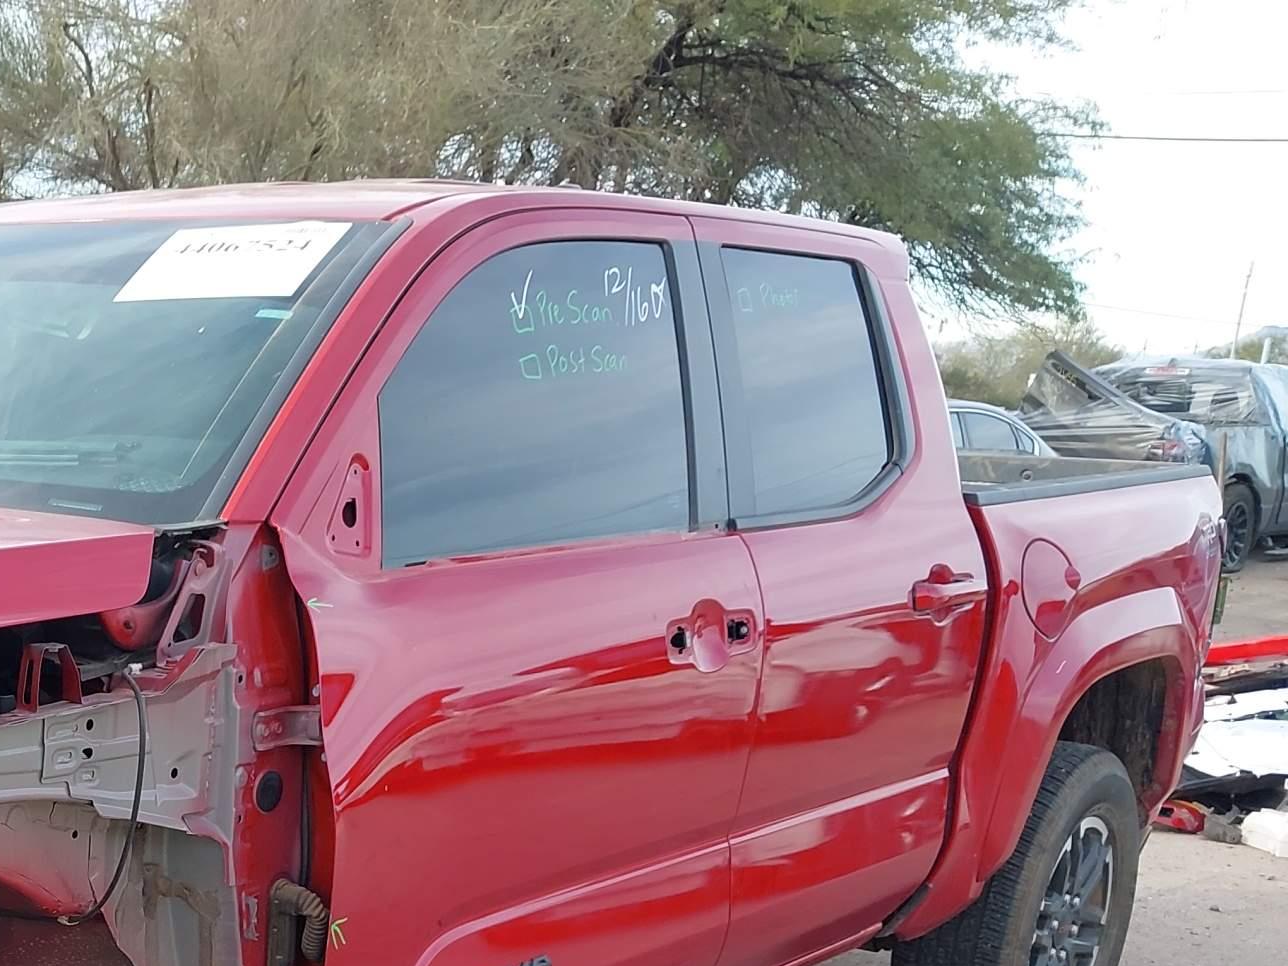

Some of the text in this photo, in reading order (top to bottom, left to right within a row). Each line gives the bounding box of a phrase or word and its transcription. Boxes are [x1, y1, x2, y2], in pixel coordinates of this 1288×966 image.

[536, 290, 563, 326] Pre
[567, 289, 612, 325] Scan
[546, 344, 628, 377] Post Scan
